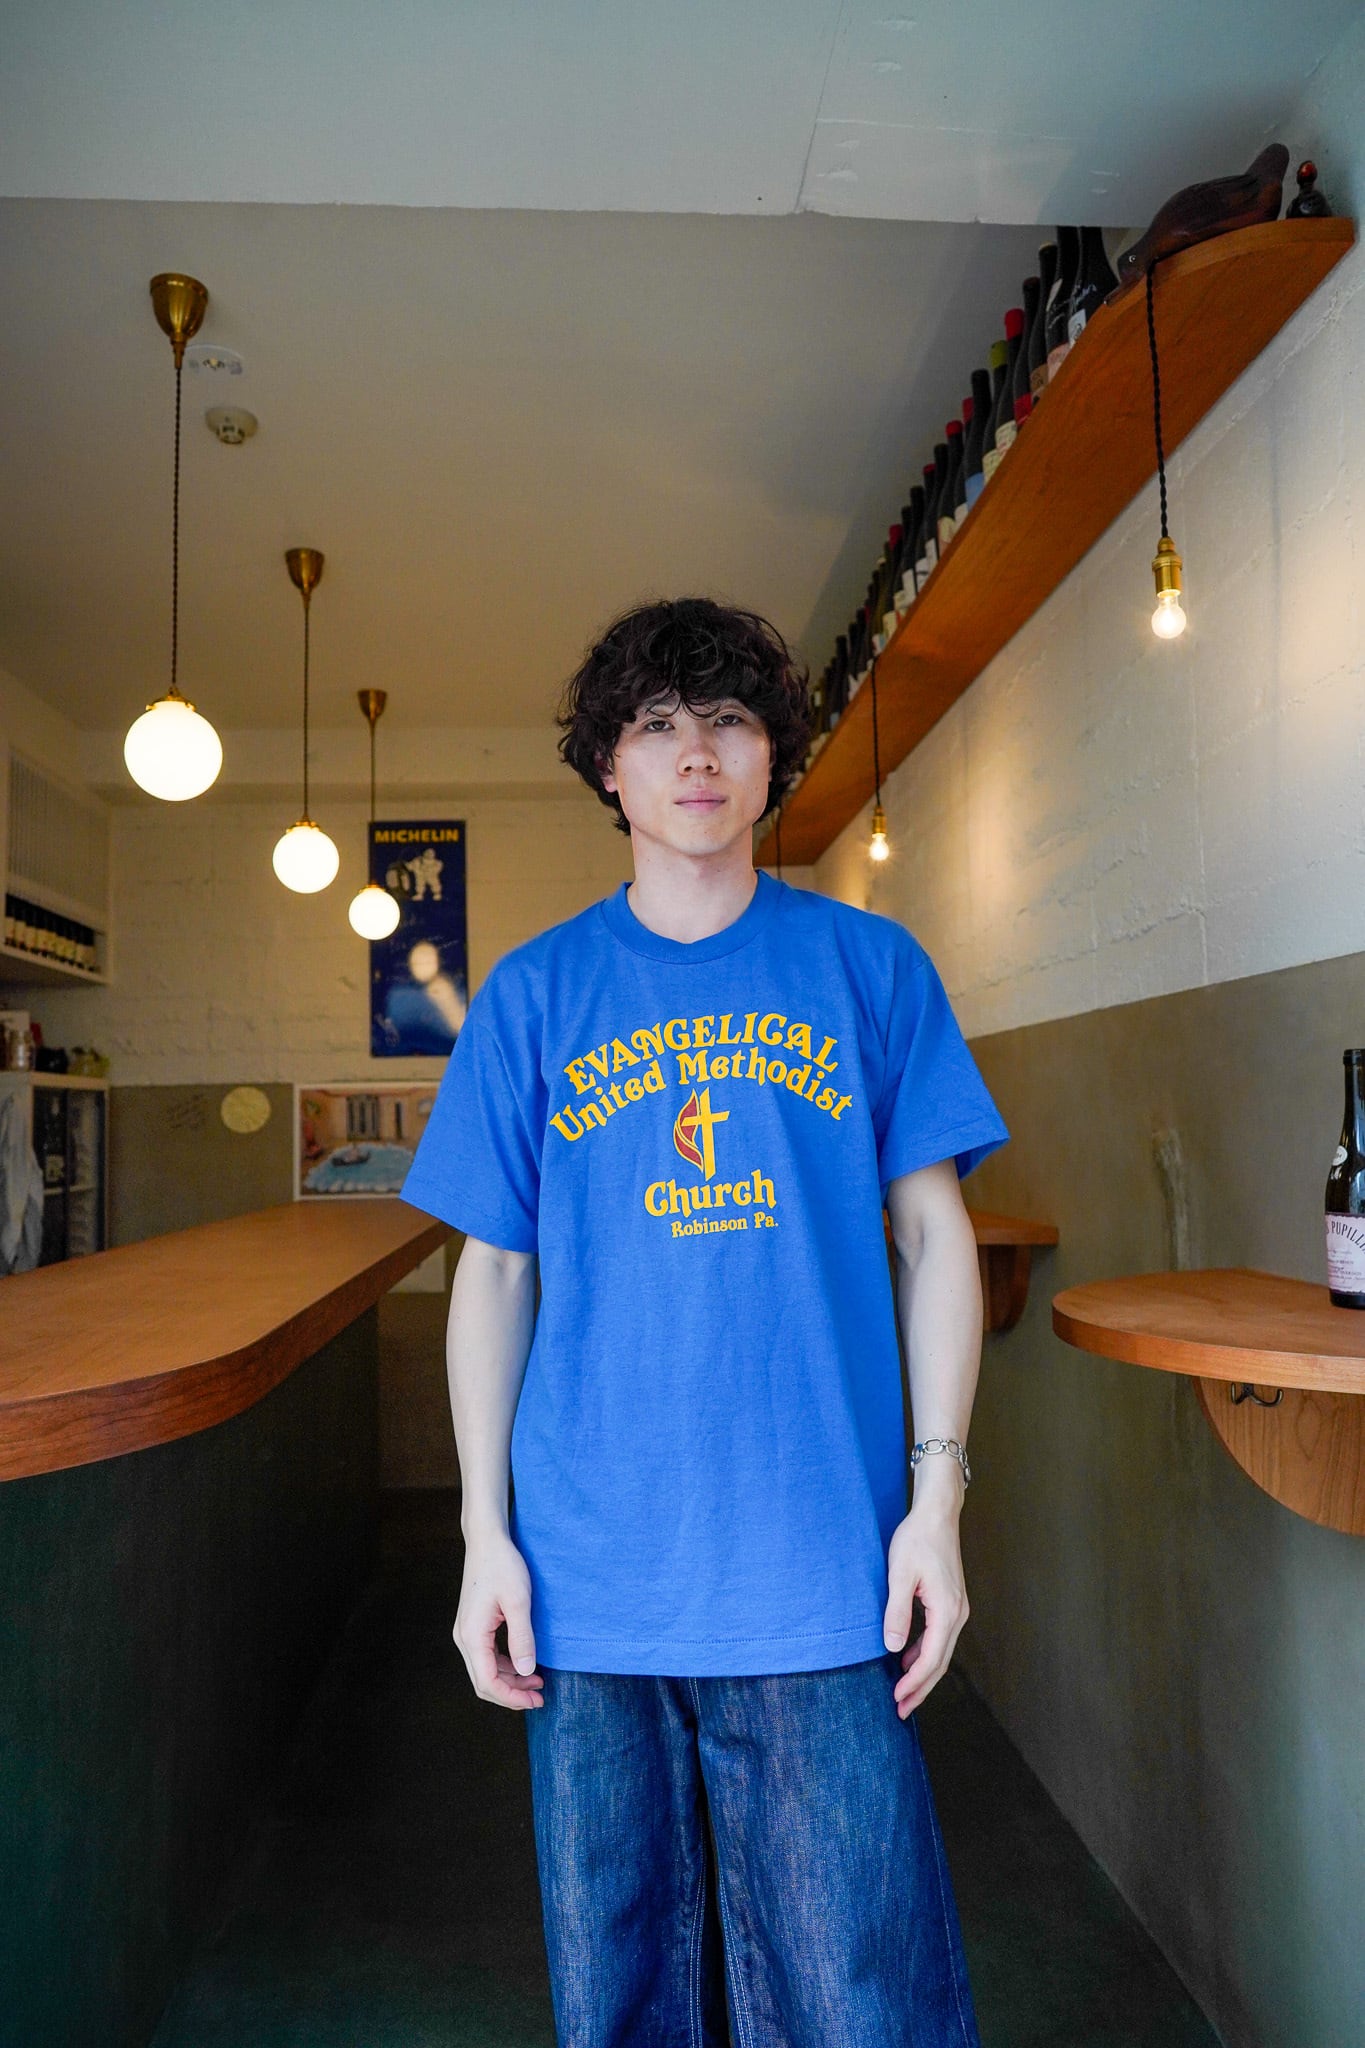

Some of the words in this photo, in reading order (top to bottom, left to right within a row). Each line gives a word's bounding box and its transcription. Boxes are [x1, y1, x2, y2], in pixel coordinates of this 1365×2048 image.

[375, 828, 459, 844] MICHELIN
[564, 1012, 838, 1095] EVANGELICAL
[549, 1060, 666, 1141] United
[675, 1048, 852, 1121] Methodist
[645, 1170, 776, 1217] Church
[671, 1218, 748, 1237] Robinson
[754, 1212, 779, 1228] Pa.
